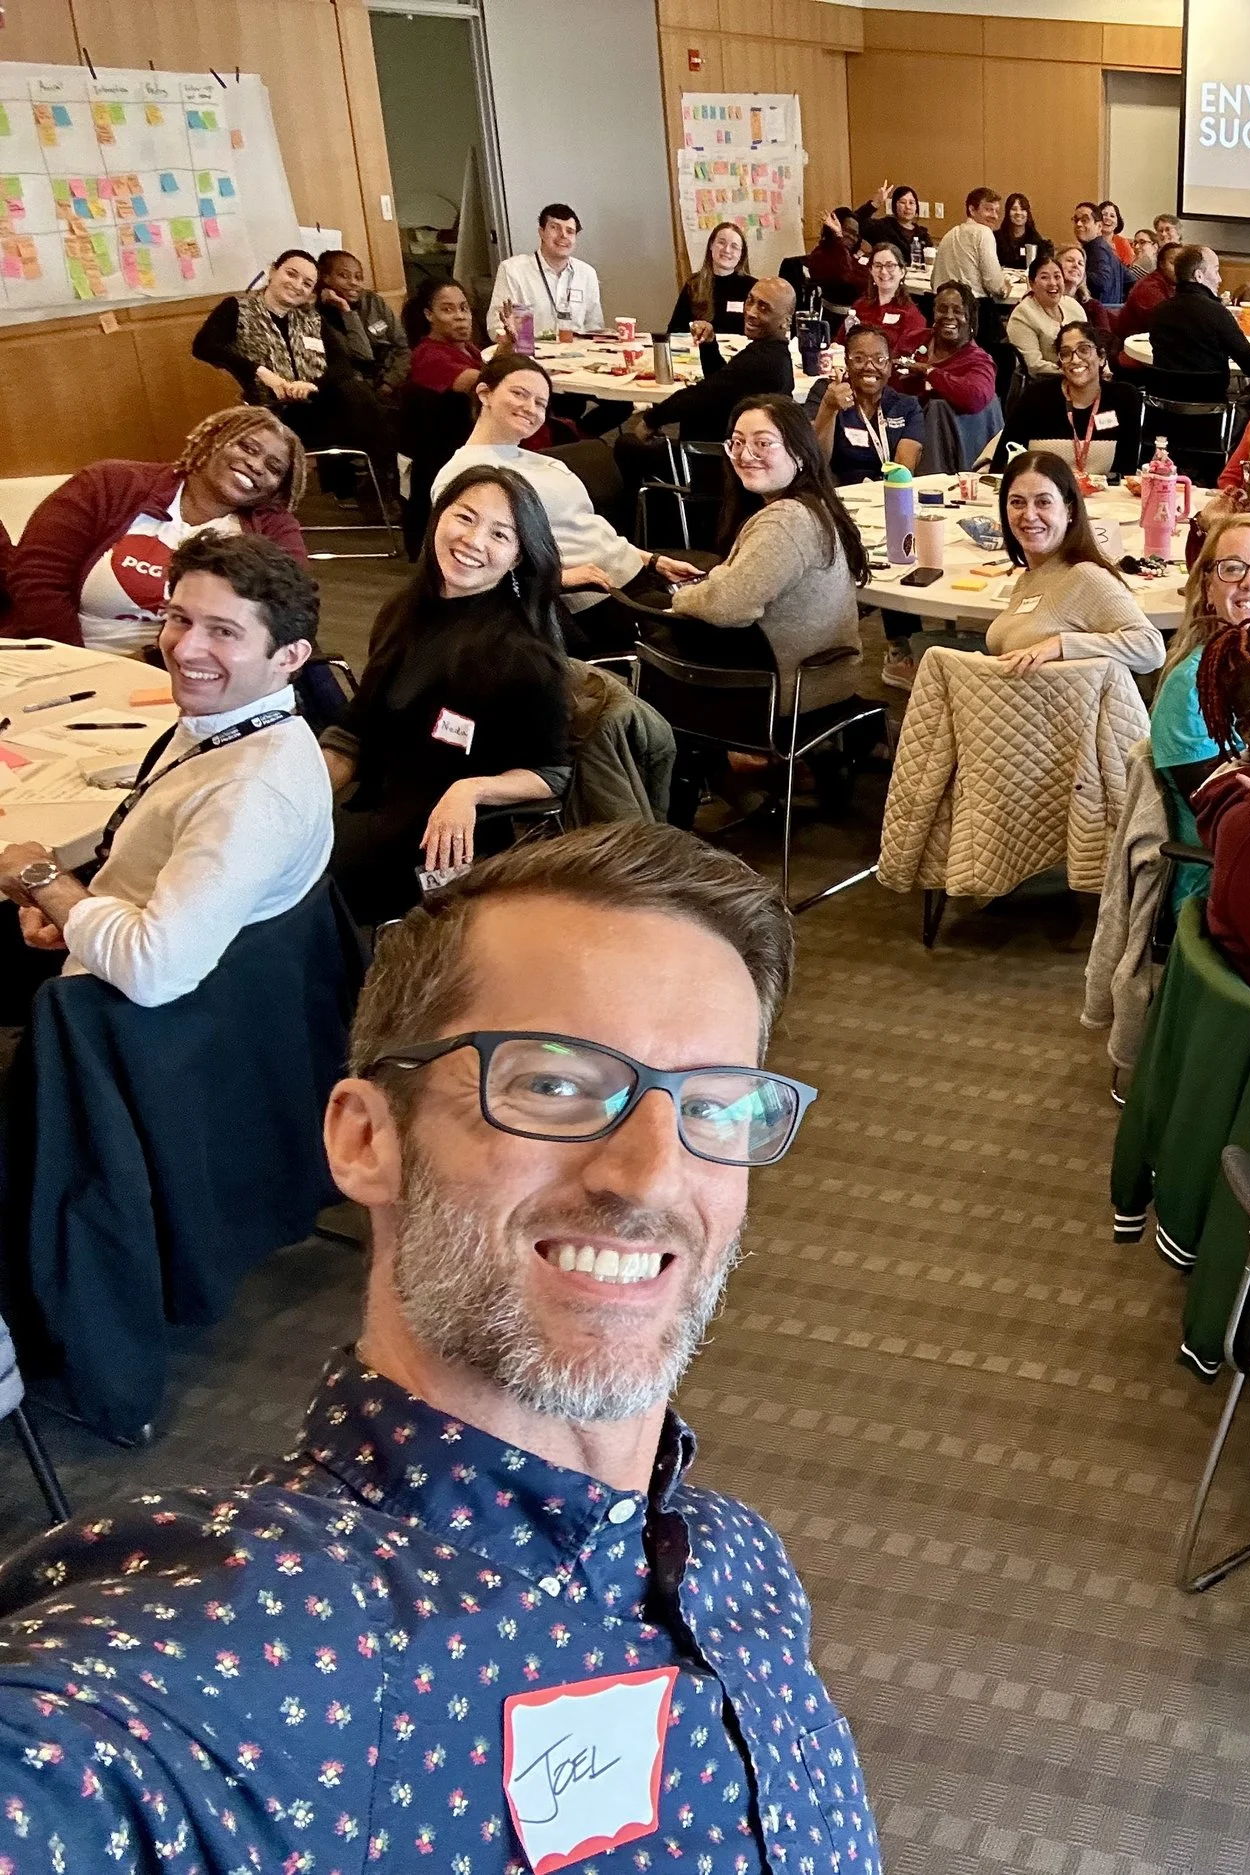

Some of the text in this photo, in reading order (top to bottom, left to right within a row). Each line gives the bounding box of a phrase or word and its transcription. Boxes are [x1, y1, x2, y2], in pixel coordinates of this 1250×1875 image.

[1094, 527, 1109, 544] 3
[121, 555, 163, 577] PCG
[514, 1732, 622, 1825] JOEL
